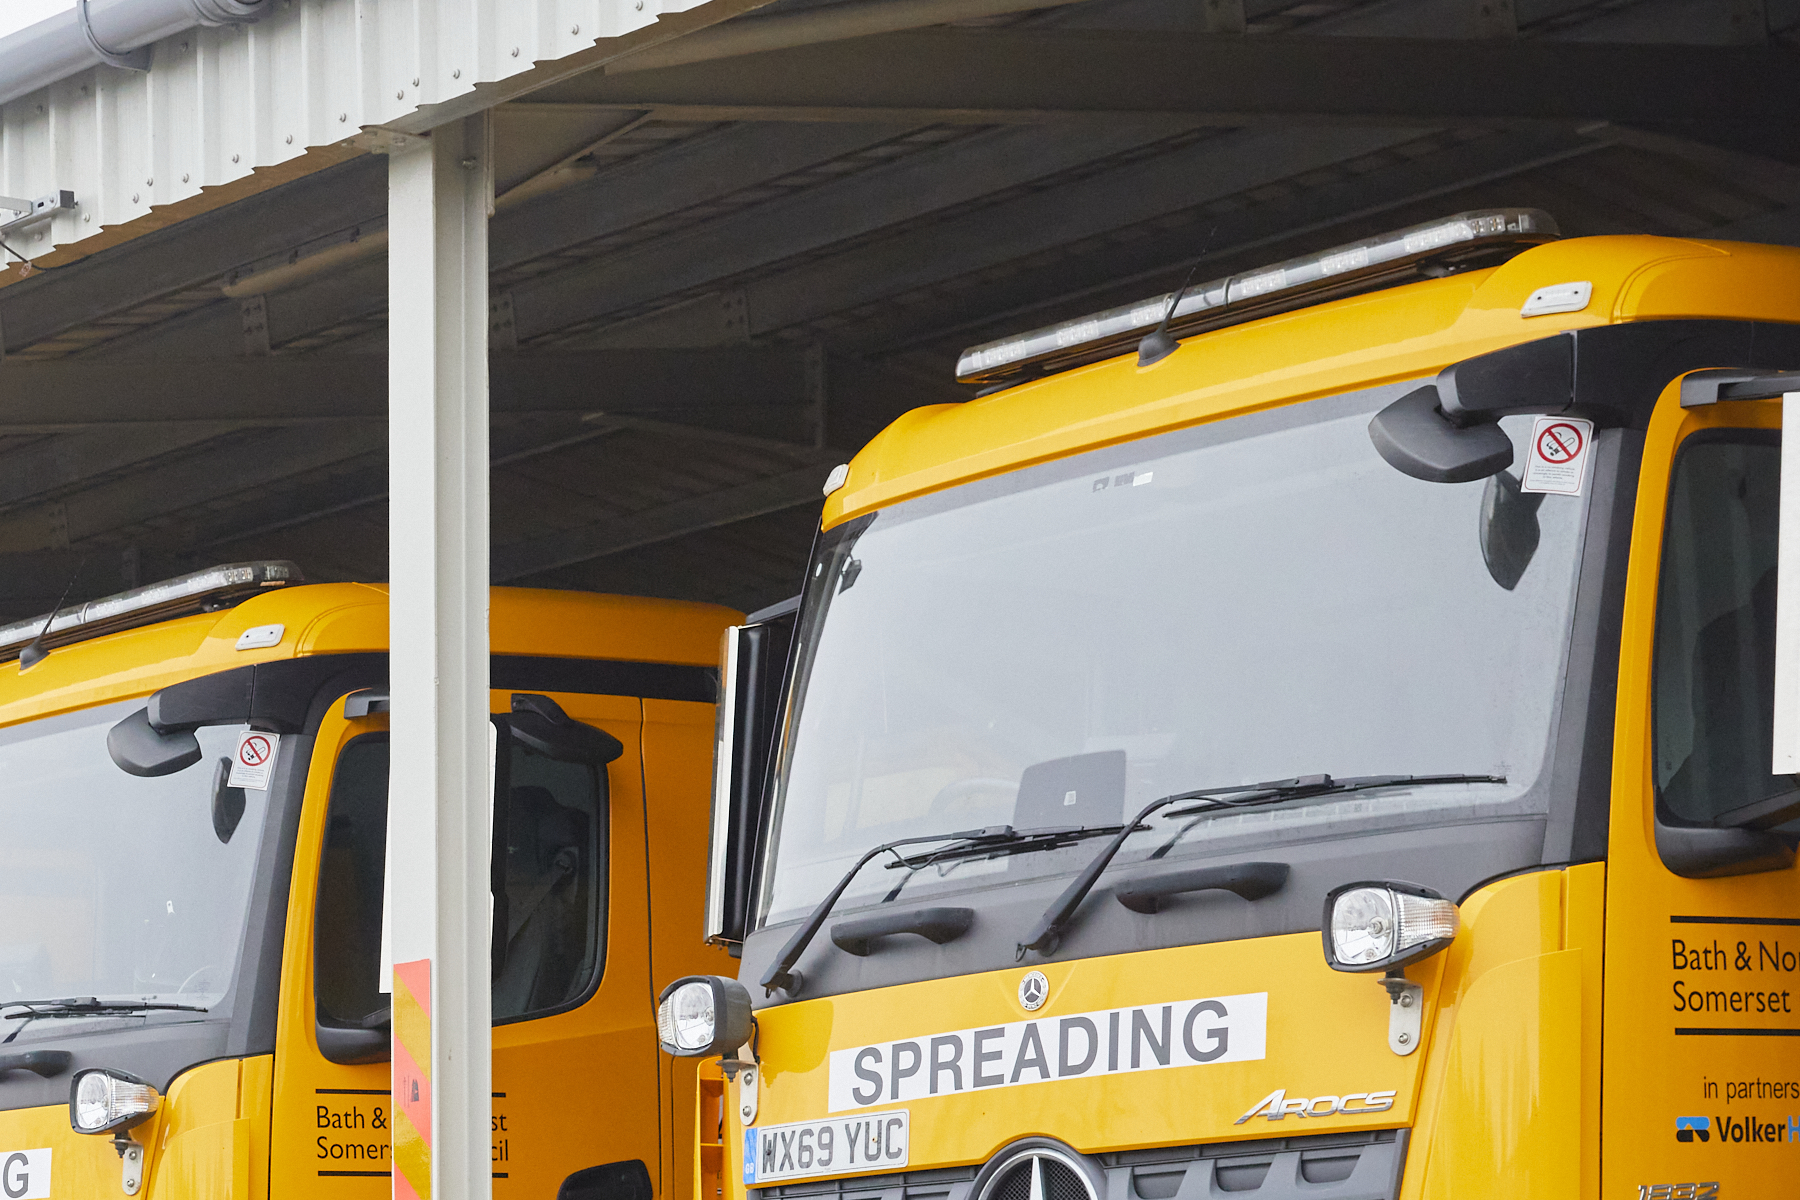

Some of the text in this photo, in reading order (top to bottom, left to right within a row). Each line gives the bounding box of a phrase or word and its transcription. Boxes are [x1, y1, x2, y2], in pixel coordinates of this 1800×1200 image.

[1671, 939, 1727, 970] Bath
[1734, 940, 1753, 971] &
[1672, 980, 1792, 1013] Somerset
[851, 999, 1230, 1106] SPREADING
[1703, 1075, 1718, 1099] in
[316, 1105, 365, 1129] Bath
[371, 1106, 388, 1130] &
[762, 1125, 835, 1174] WX69
[844, 1117, 904, 1164] YUC
